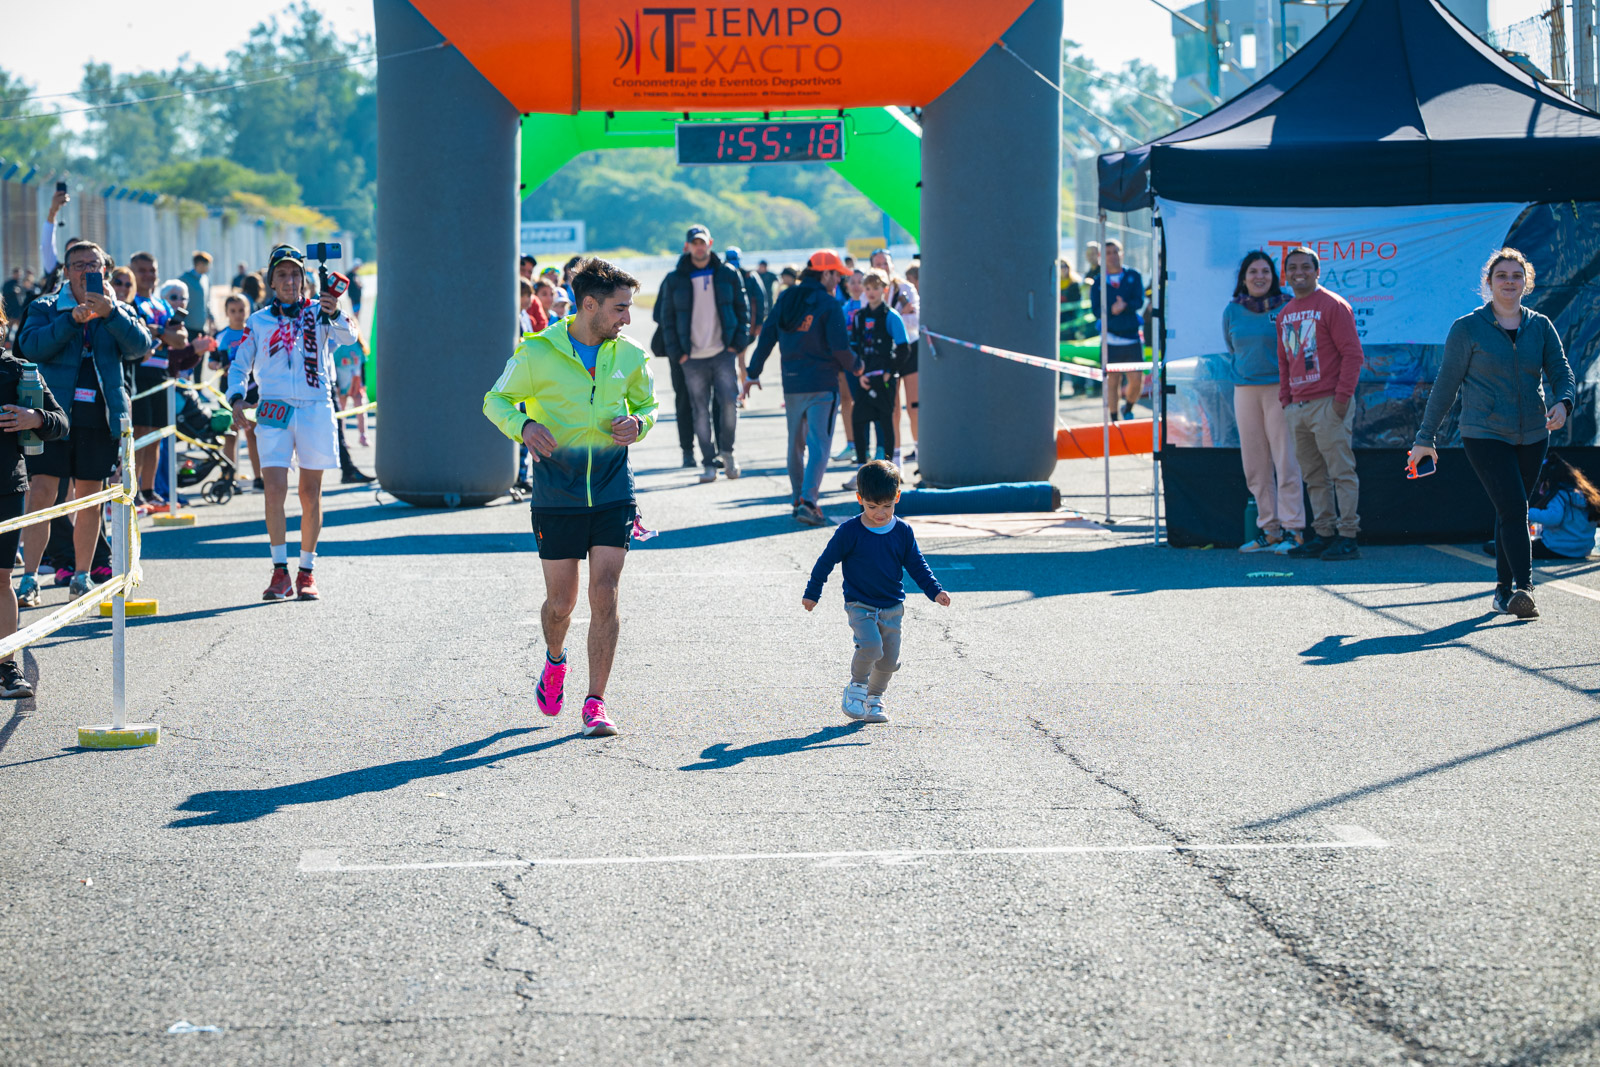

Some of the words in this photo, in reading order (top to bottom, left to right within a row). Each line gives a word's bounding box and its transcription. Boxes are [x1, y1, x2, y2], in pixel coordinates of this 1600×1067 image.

[677, 17, 843, 74] EXACTO
[613, 76, 698, 89] Cronometraje
[700, 77, 716, 87] de
[719, 77, 769, 87] Eventos
[772, 75, 842, 88] Deportivos
[717, 123, 840, 161] 1:55:18
[260, 401, 286, 421] 370
